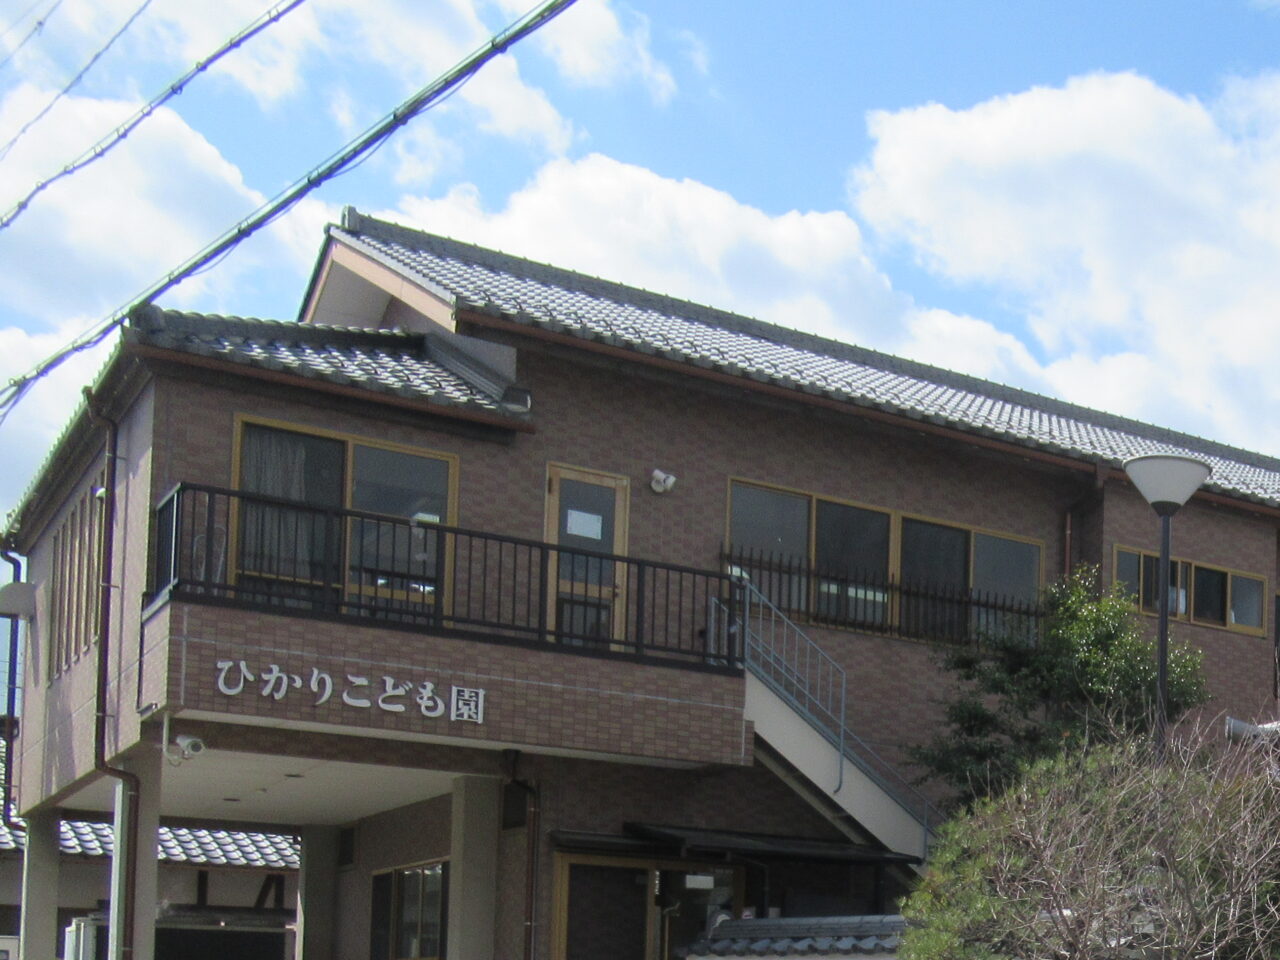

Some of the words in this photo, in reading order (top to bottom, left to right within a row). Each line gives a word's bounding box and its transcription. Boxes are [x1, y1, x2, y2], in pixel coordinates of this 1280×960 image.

[216, 660, 485, 724] ひかりこども園
